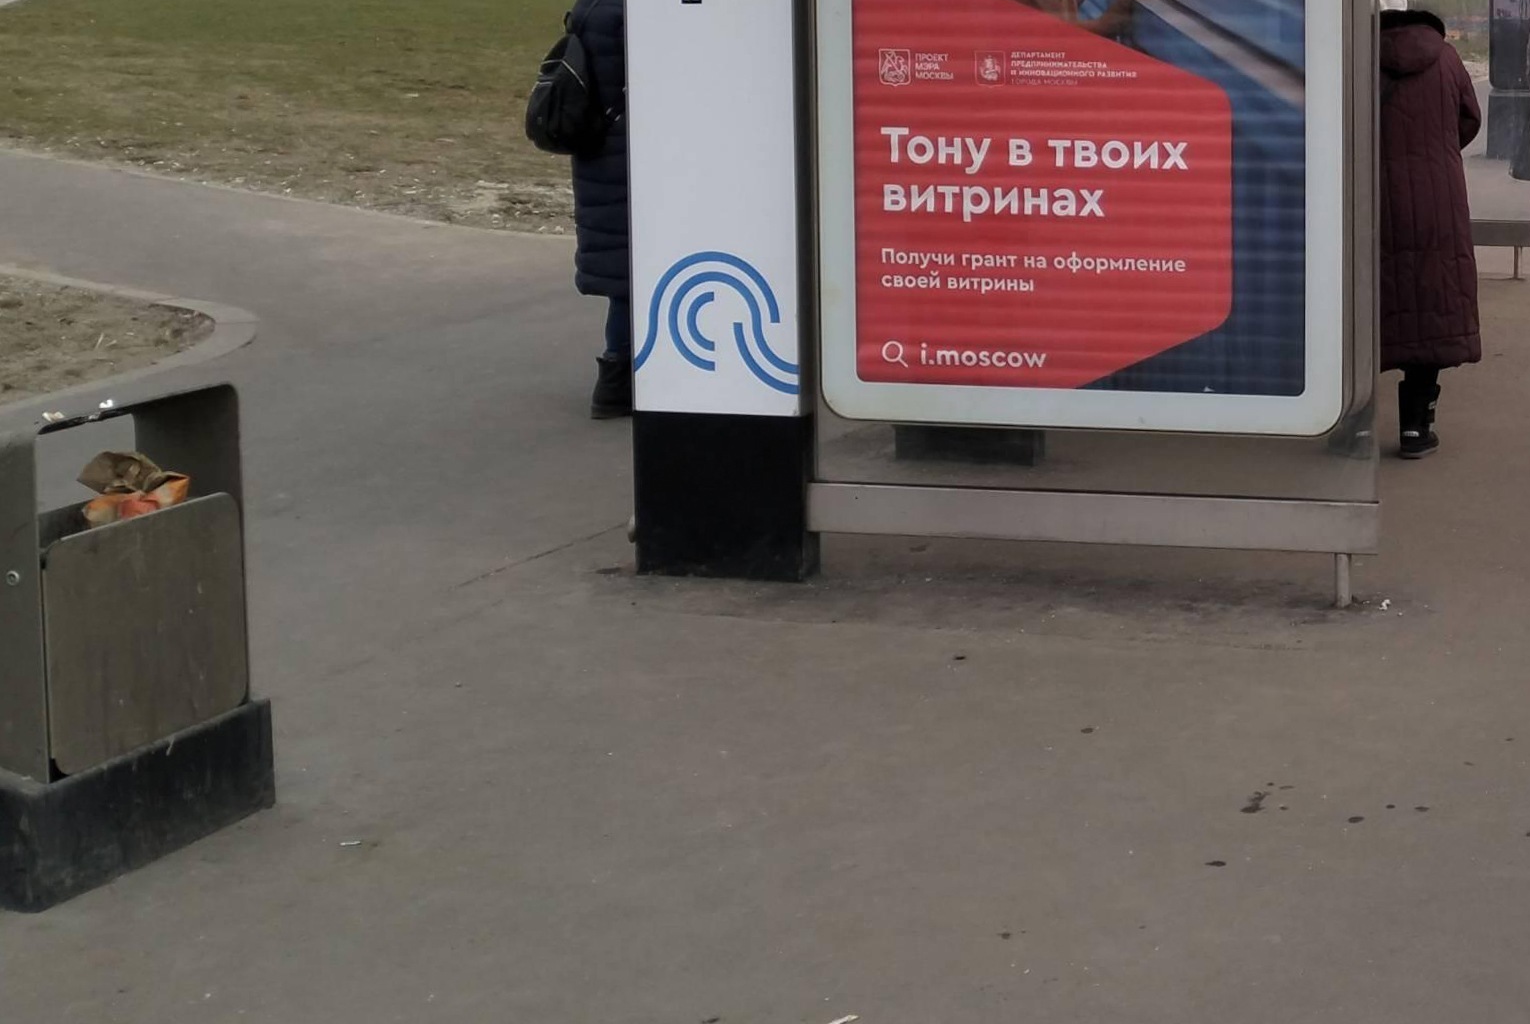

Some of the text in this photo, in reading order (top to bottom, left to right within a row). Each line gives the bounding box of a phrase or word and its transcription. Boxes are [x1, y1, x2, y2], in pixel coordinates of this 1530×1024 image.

[914, 62, 940, 71] МЭРА
[915, 52, 949, 62] ПРОЕКТ
[1010, 51, 1066, 59] ДЕПАРТАМЕНТ
[915, 71, 954, 80] МОСКВЫ
[881, 127, 1188, 175] Тону в твоих
[883, 184, 1105, 223] витринах
[881, 248, 1187, 274] Получи грант на оформление
[881, 270, 1035, 295] своей витрины
[920, 343, 1047, 368] i.moscow
